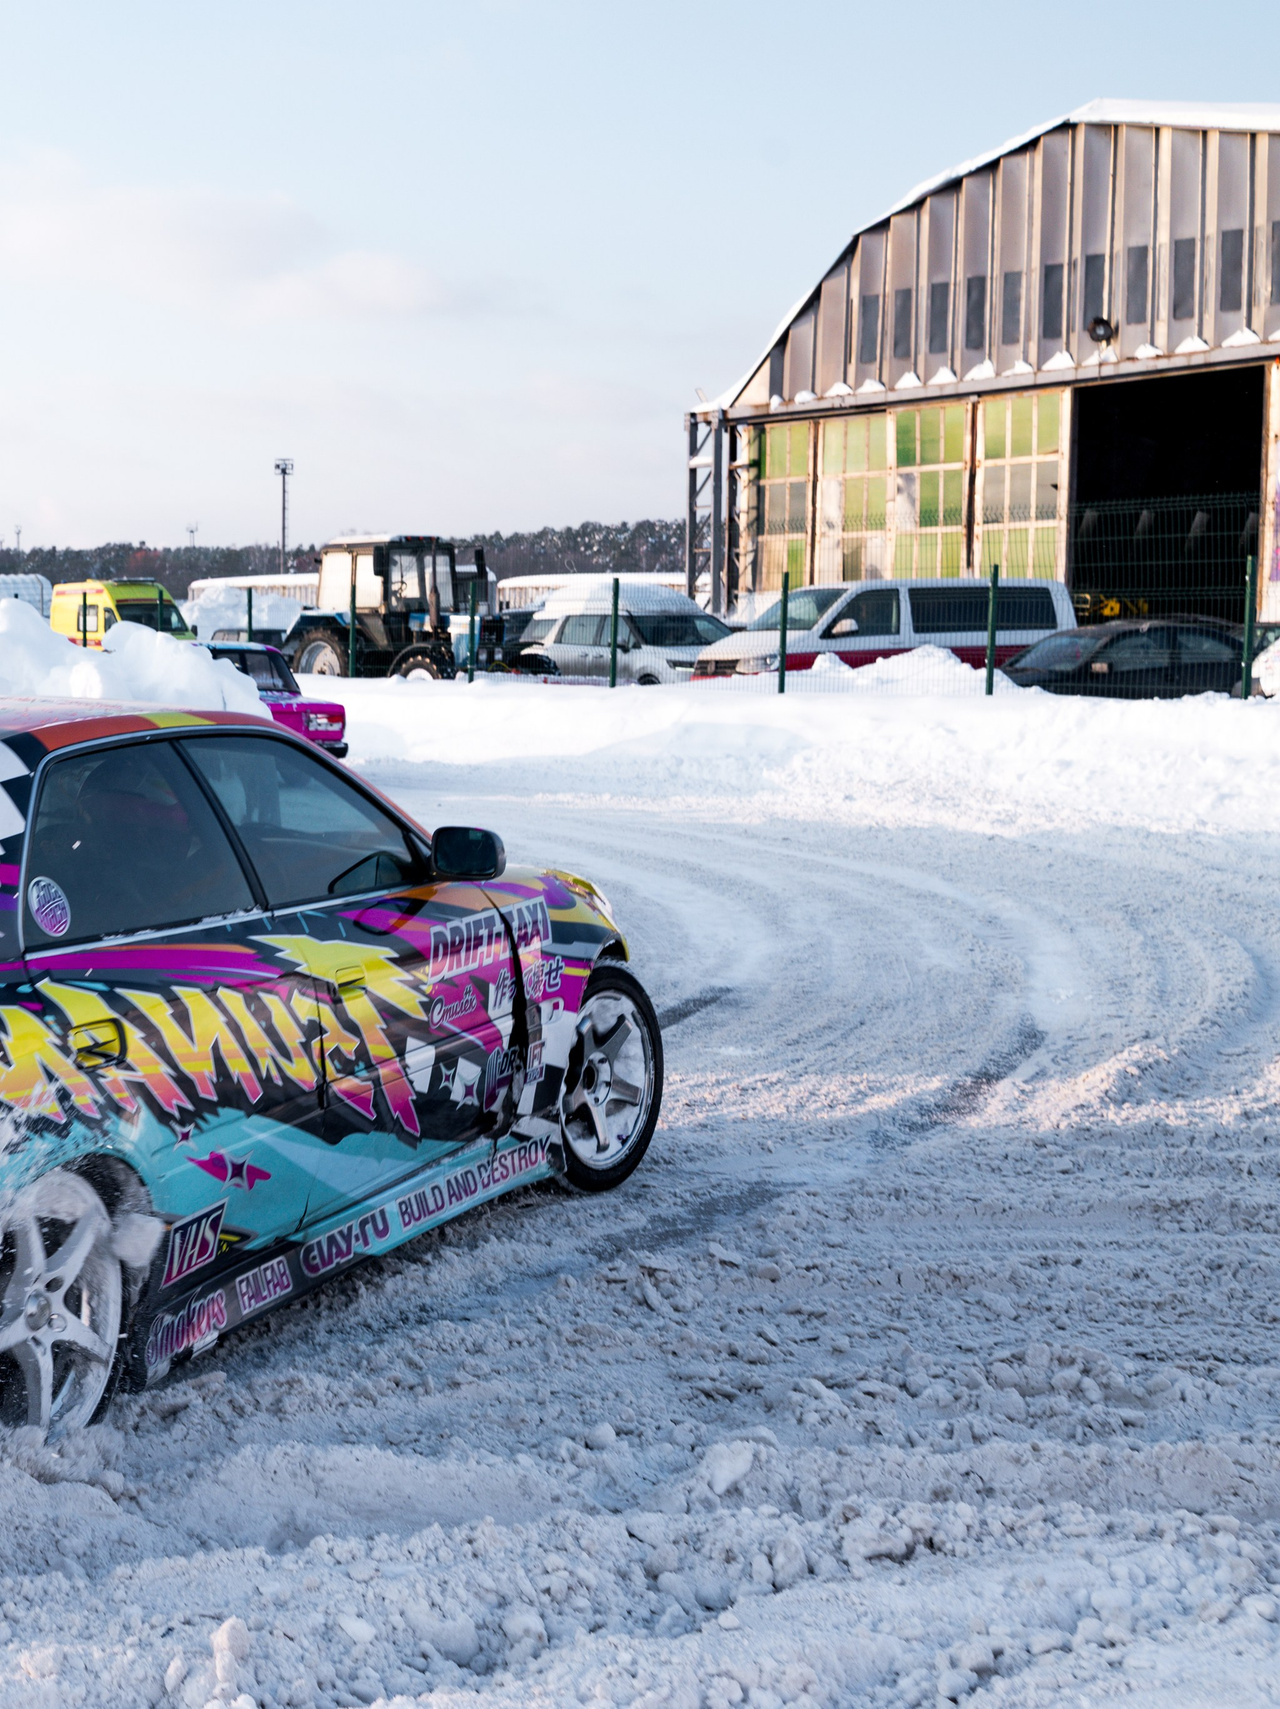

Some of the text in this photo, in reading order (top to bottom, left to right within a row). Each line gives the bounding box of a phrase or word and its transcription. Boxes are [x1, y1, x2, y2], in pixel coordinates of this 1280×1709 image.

[429, 900, 550, 981] DRIFT TAXI
[172, 1210, 223, 1278] VHS
[240, 1260, 292, 1308] FAILFAB
[398, 1187, 446, 1228] BUILD
[447, 1168, 480, 1206] AND
[478, 1135, 550, 1187] DESTROY
